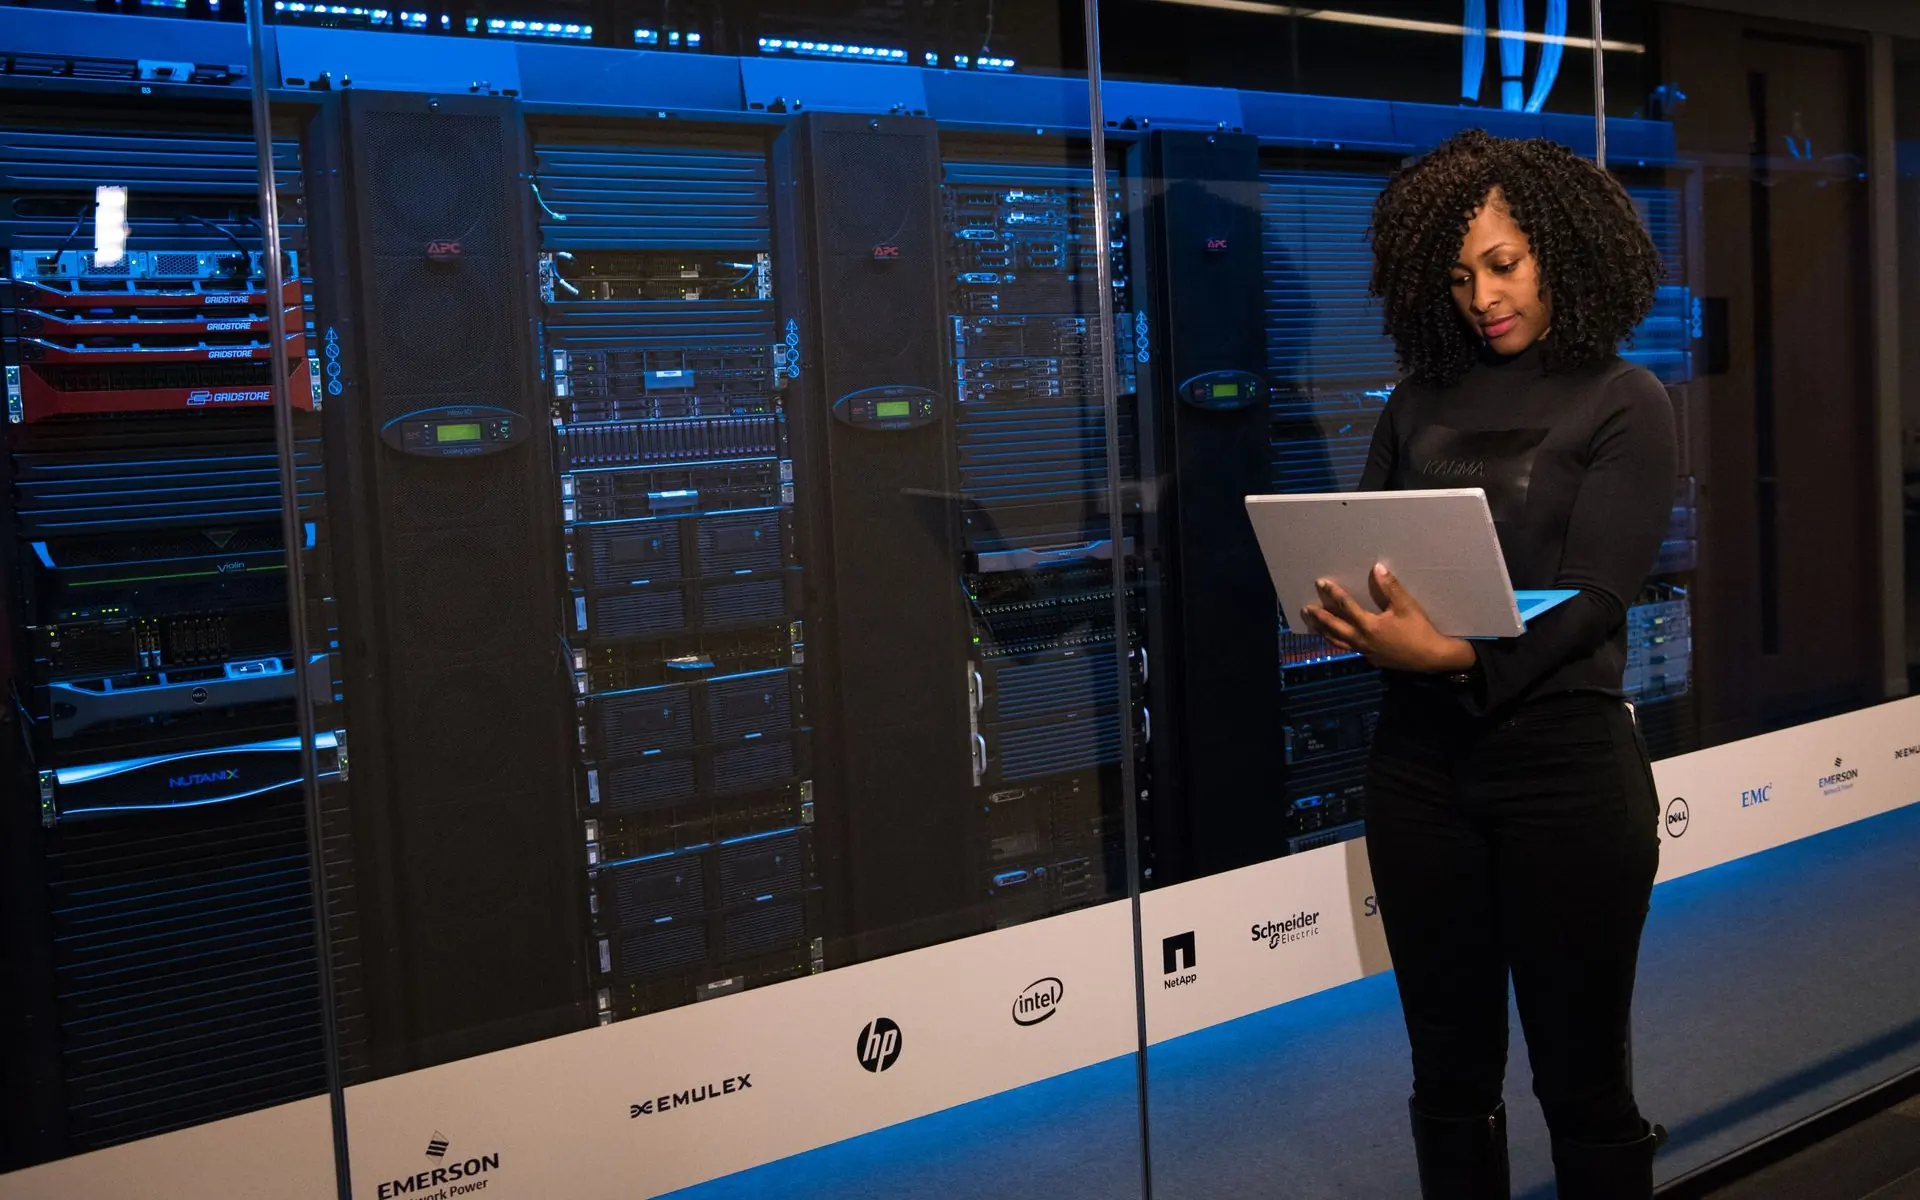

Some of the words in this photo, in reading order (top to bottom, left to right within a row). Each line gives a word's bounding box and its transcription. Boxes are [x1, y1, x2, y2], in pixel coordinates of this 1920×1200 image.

[428, 243, 461, 254] APC
[874, 247, 899, 256] APC
[1207, 240, 1227, 248] APC
[205, 296, 250, 304] GRIDSTORE
[207, 322, 251, 331] GRIDSTORE
[208, 350, 253, 358] GRIDSTORE
[213, 391, 270, 402] GRIDSTORE
[217, 562, 245, 573] Violin
[169, 768, 238, 788] NUTANIX
[1818, 769, 1858, 788] EMERSON
[1668, 811, 1687, 825] DELL
[1251, 911, 1319, 941] Schneider
[1282, 927, 1319, 944] Electric
[1164, 973, 1197, 990] NetApp
[1019, 986, 1055, 1013] intel
[862, 1018, 898, 1073] hp
[657, 1074, 752, 1113] EMULEX
[377, 1152, 500, 1200] EMERSON
[450, 1178, 489, 1198] Power
